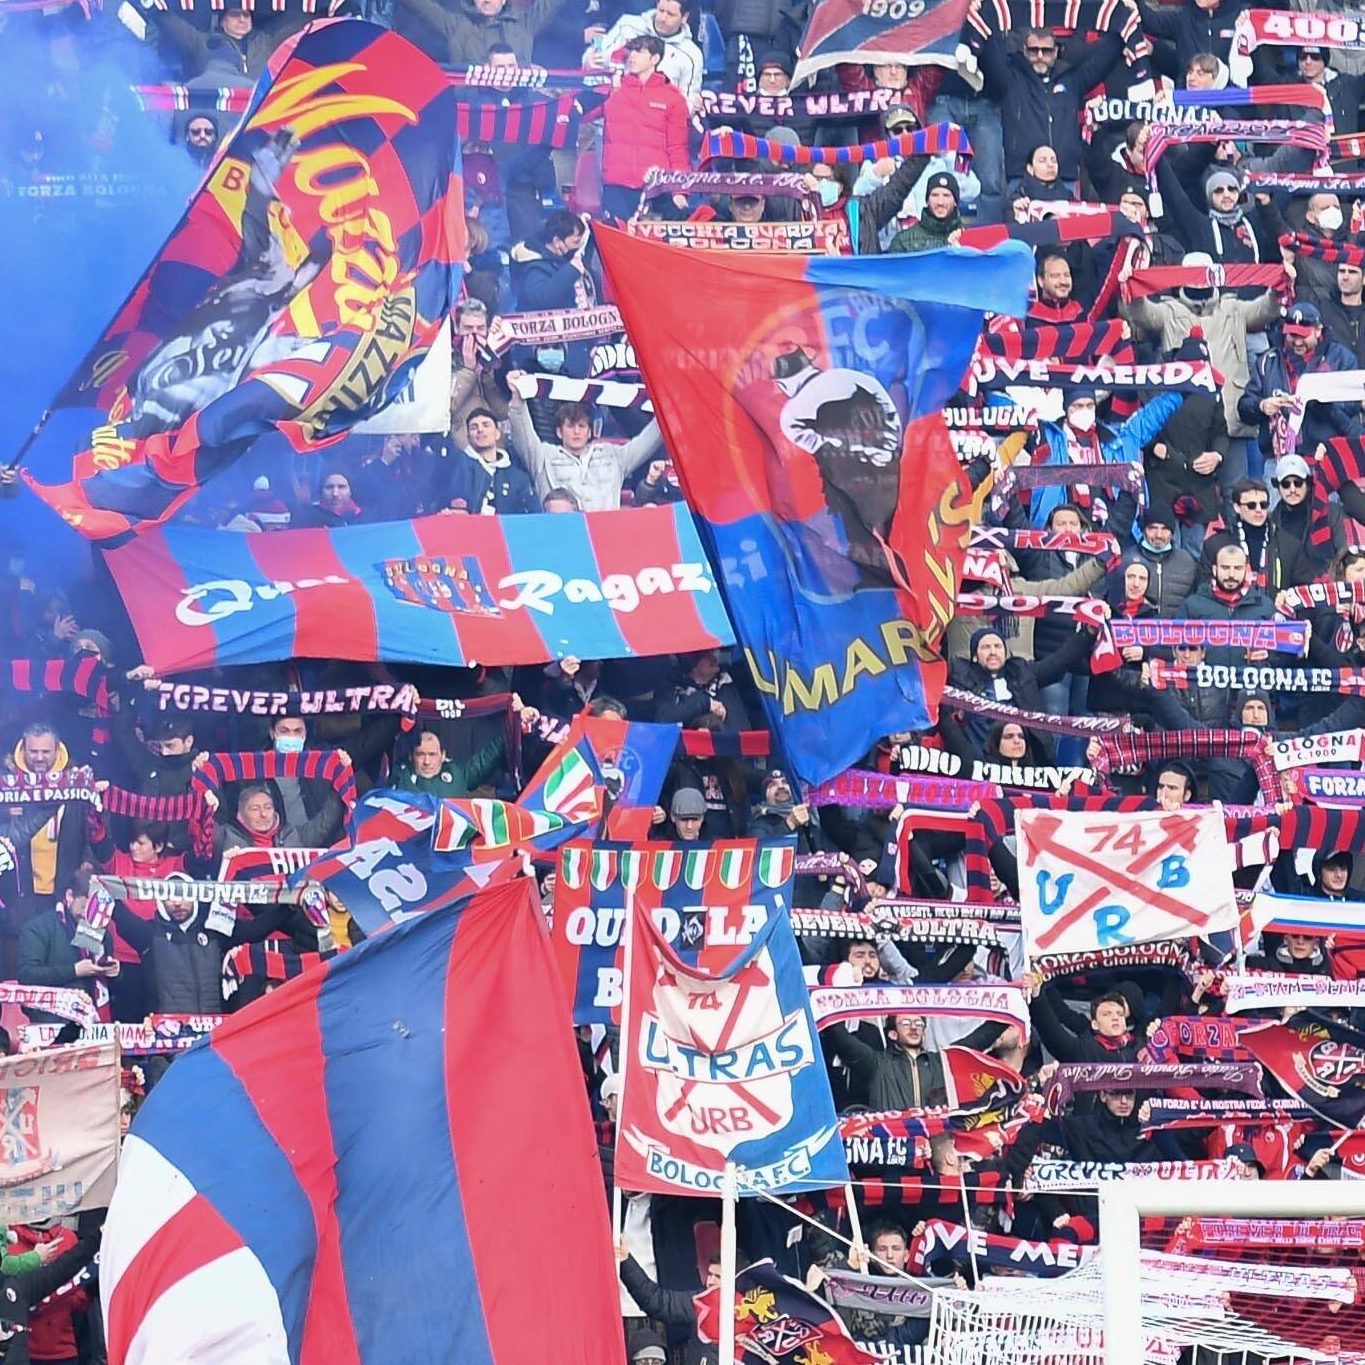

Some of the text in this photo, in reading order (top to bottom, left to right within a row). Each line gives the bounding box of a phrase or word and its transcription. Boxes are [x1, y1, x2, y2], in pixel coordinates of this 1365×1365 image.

[647, 165, 739, 191] Bologna
[745, 224, 841, 240] GUARDIA
[512, 314, 557, 335] FORZA
[1072, 360, 1213, 389] MERDA
[385, 562, 469, 581] BOLOGNA
[1112, 620, 1277, 649] BOLOGNA
[1197, 664, 1333, 692] BOLOGNA FC
[158, 682, 287, 714] FOREVER
[944, 686, 1119, 733] Bologna 1909
[972, 758, 1092, 791] FIRENZE
[34, 790, 44, 803] E
[1085, 824, 1146, 855] 74
[137, 878, 247, 904] BOLOGNA
[1035, 851, 1191, 915] U B
[1093, 906, 1134, 947] R
[1103, 956, 1147, 968] Gloria
[687, 991, 723, 1010] 74
[815, 989, 1012, 1011] FORZA BOLOGNA
[690, 1107, 754, 1134] URB
[767, 1158, 809, 1192] F.C.
